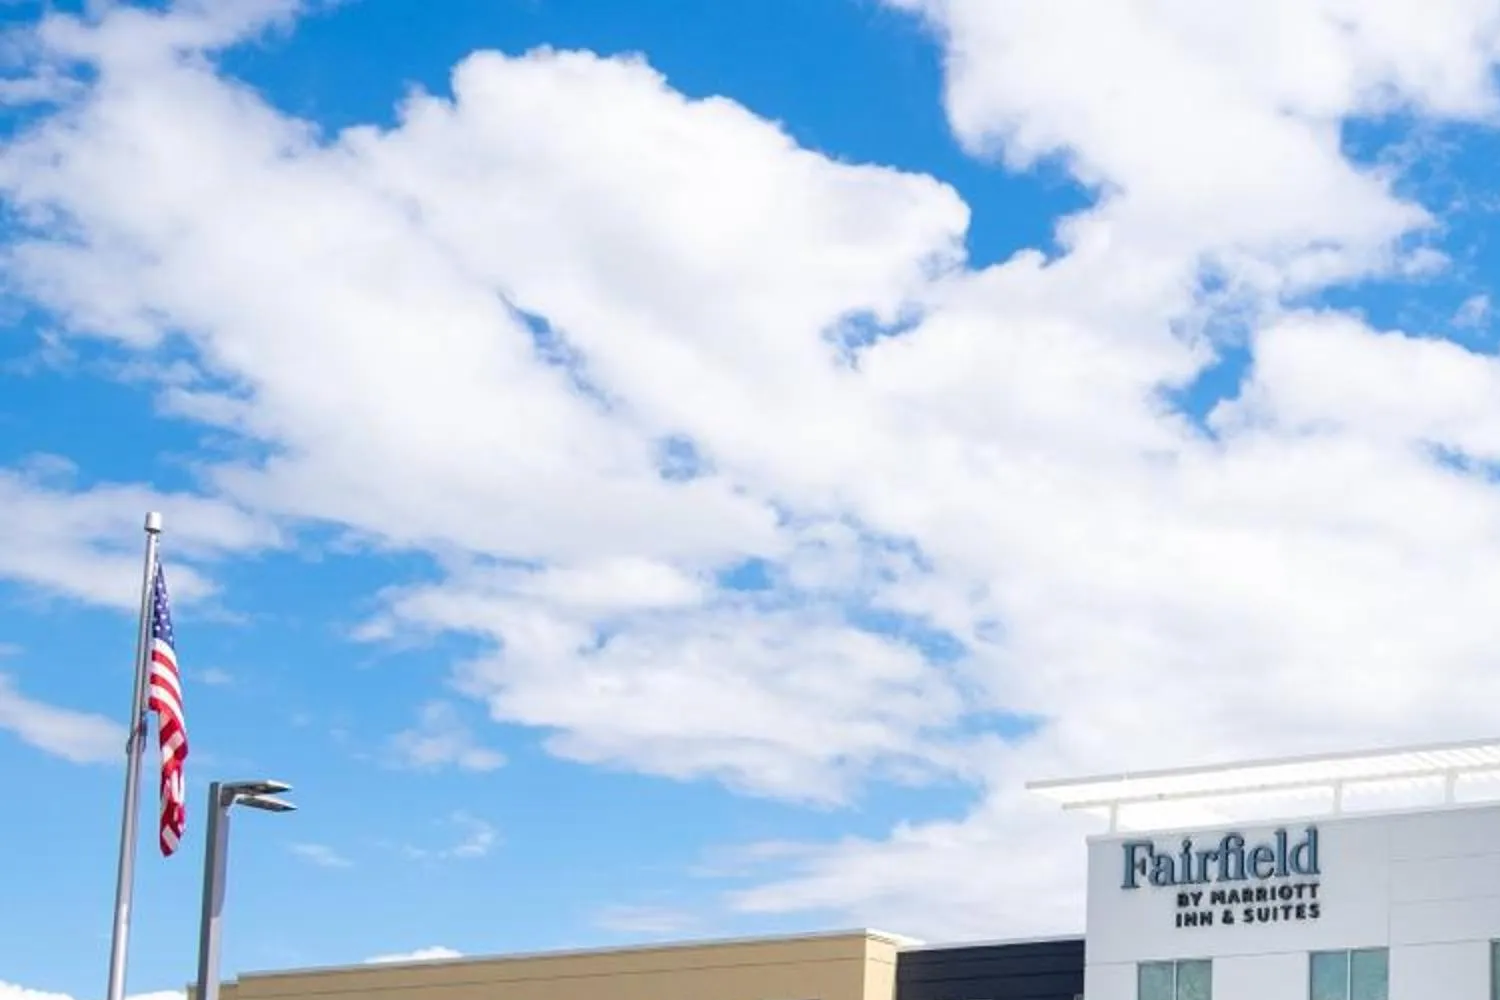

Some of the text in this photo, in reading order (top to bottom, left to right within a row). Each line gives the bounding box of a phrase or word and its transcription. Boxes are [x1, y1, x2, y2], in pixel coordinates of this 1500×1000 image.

[1121, 825, 1321, 889] Fairfield
[1177, 883, 1320, 908] BY MARRIOTT
[1175, 903, 1321, 928] INN & SUITES
